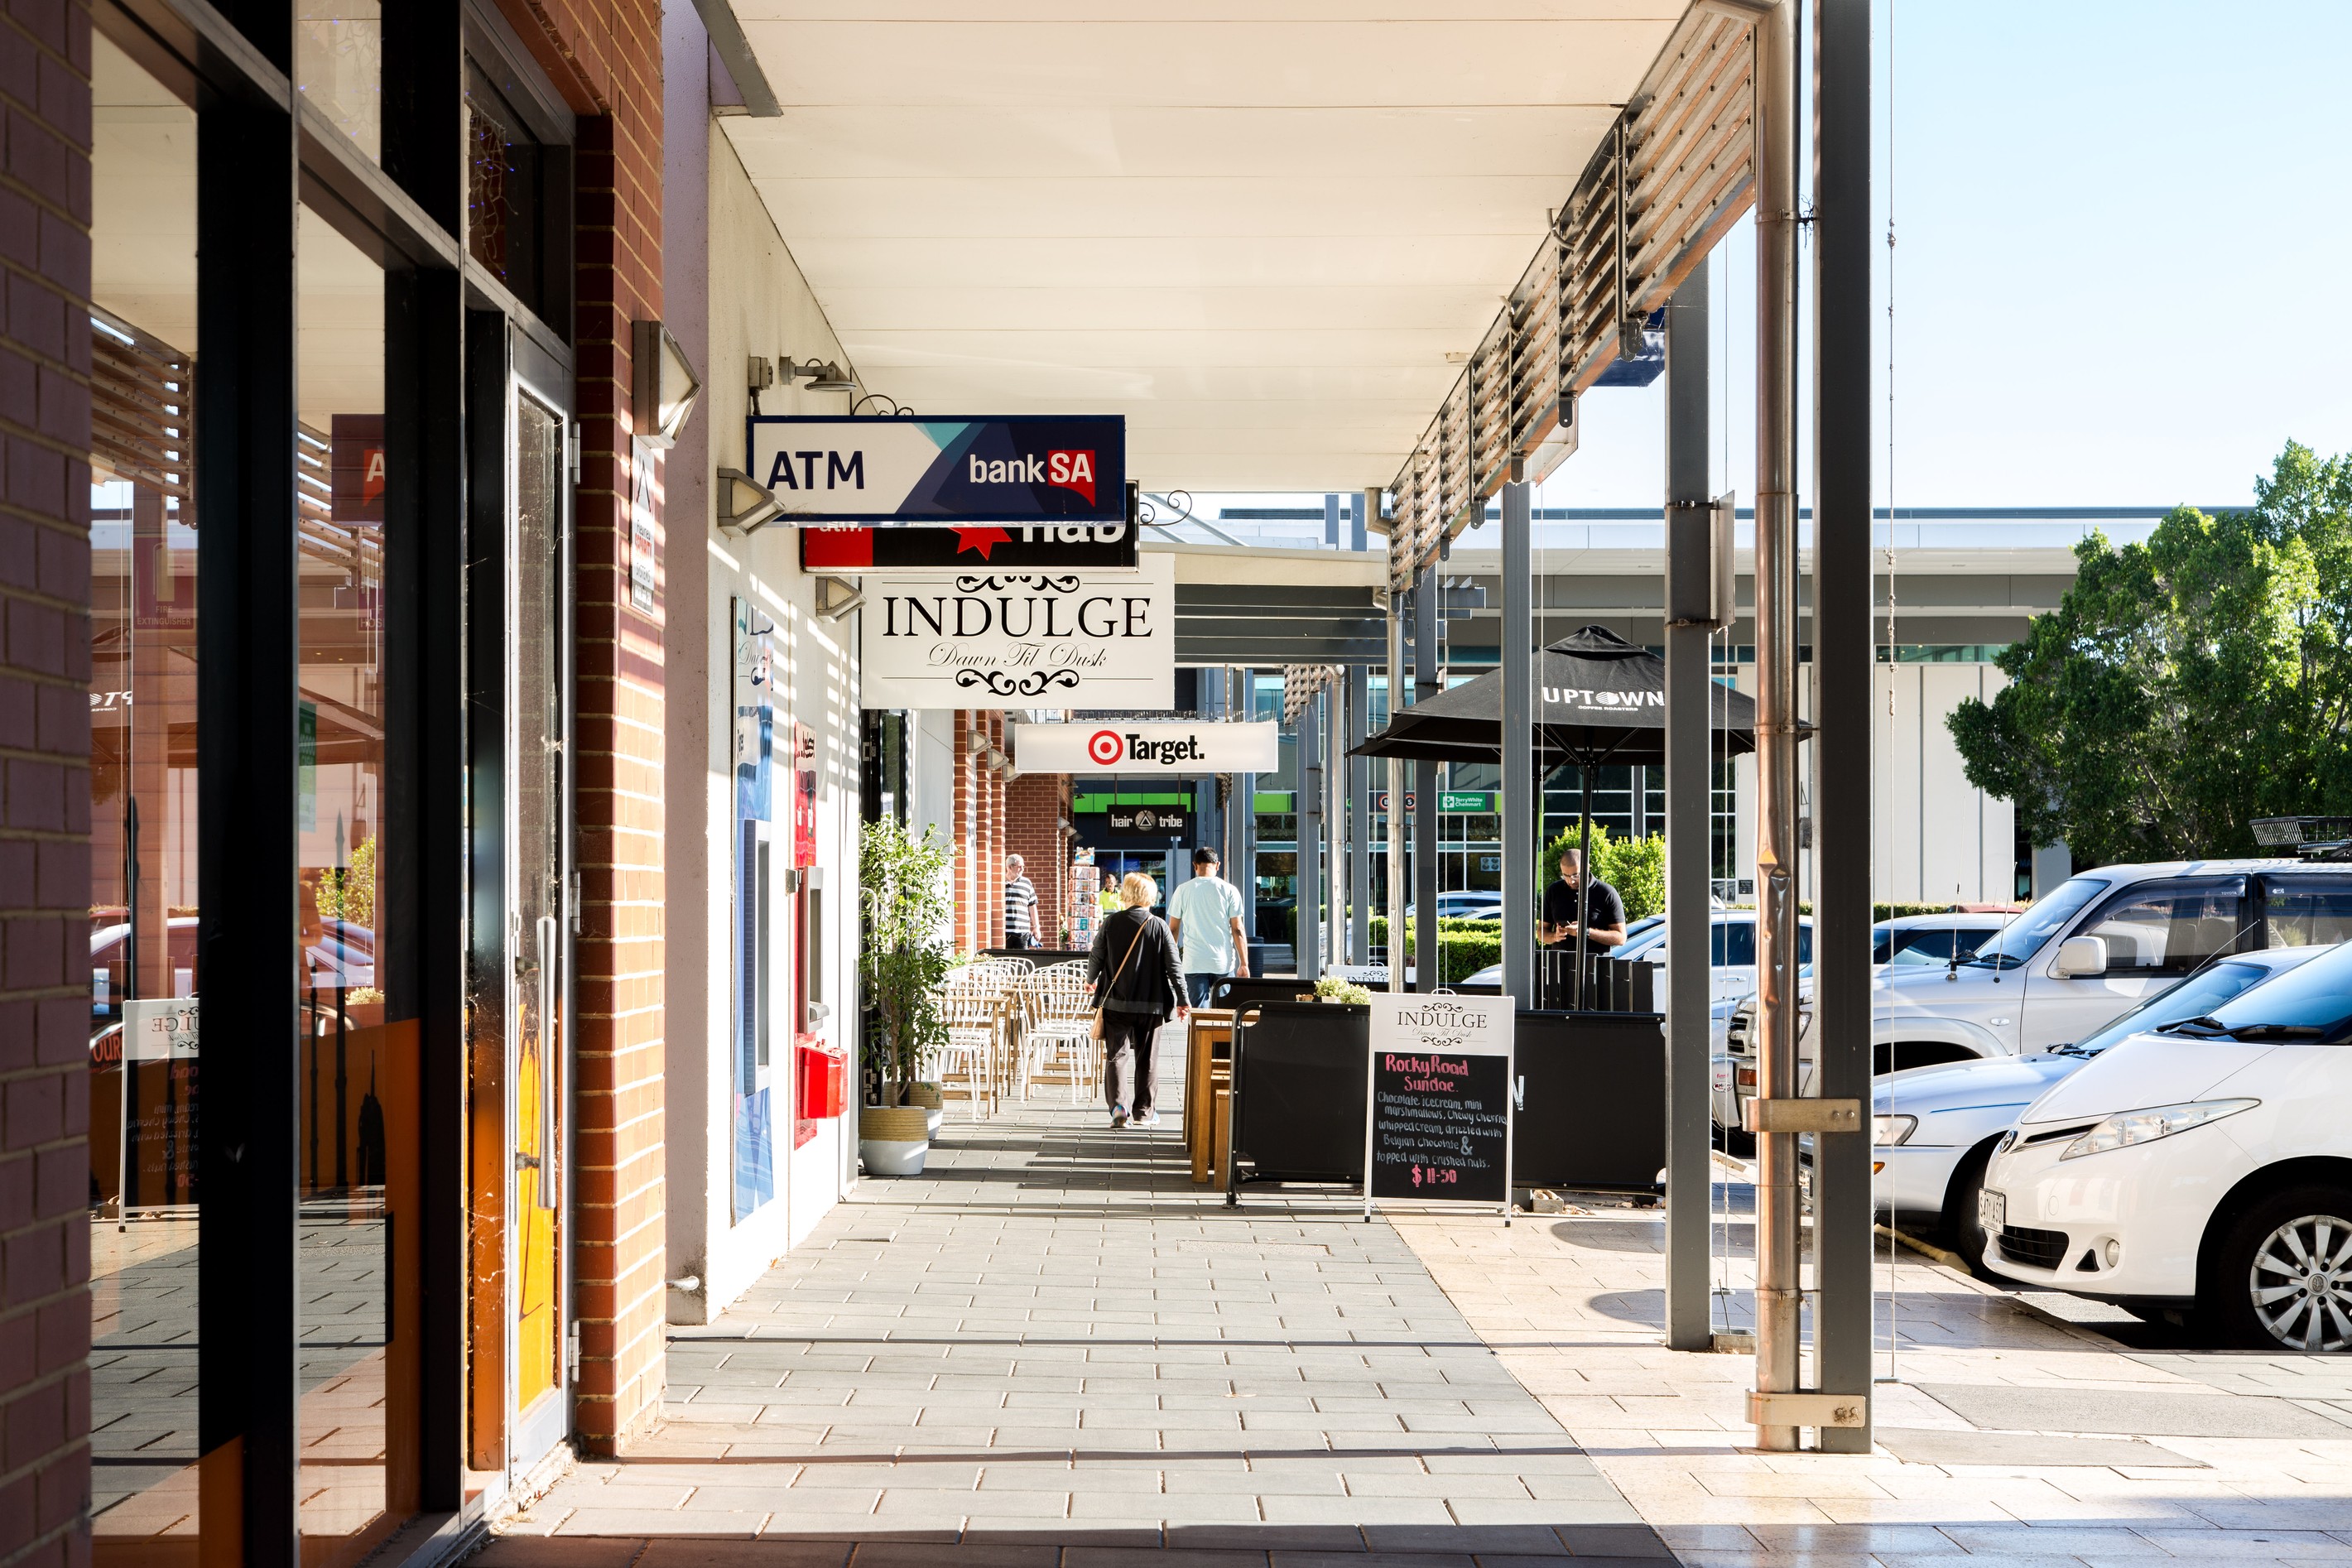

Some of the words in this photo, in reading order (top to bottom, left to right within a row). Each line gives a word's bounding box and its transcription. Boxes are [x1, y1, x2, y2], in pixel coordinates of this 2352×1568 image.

[767, 450, 865, 490] ATM
[156, 605, 173, 613] FIRE
[883, 596, 1152, 637] INDULGE
[137, 617, 191, 626] EXTINGUISHER
[926, 642, 997, 667] Dawn
[1003, 642, 1046, 666] Til
[1049, 642, 1108, 667] Dusk
[1542, 686, 1666, 706] UPTOWN
[1111, 814, 1133, 827] hair
[1159, 814, 1183, 827] tribe
[1397, 1011, 1488, 1029] INDULGE
[1412, 1027, 1436, 1037] Dawn
[1452, 1029, 1472, 1037] Dusk
[1385, 1054, 1430, 1078] Rocky
[1430, 1054, 1469, 1076] Road
[1378, 1091, 1420, 1106] Chocolate
[1465, 1099, 1482, 1110] mini
[1378, 1120, 1414, 1133] whipped
[1445, 1124, 1481, 1136] drizzled
[1483, 1128, 1503, 1138] with
[1383, 1133, 1415, 1149] Belgian
[1417, 1137, 1460, 1150] chocolate
[1460, 1136, 1473, 1156] &
[1377, 1150, 1407, 1164] topped
[1409, 1153, 1429, 1164] with
[1431, 1155, 1466, 1167] crushed
